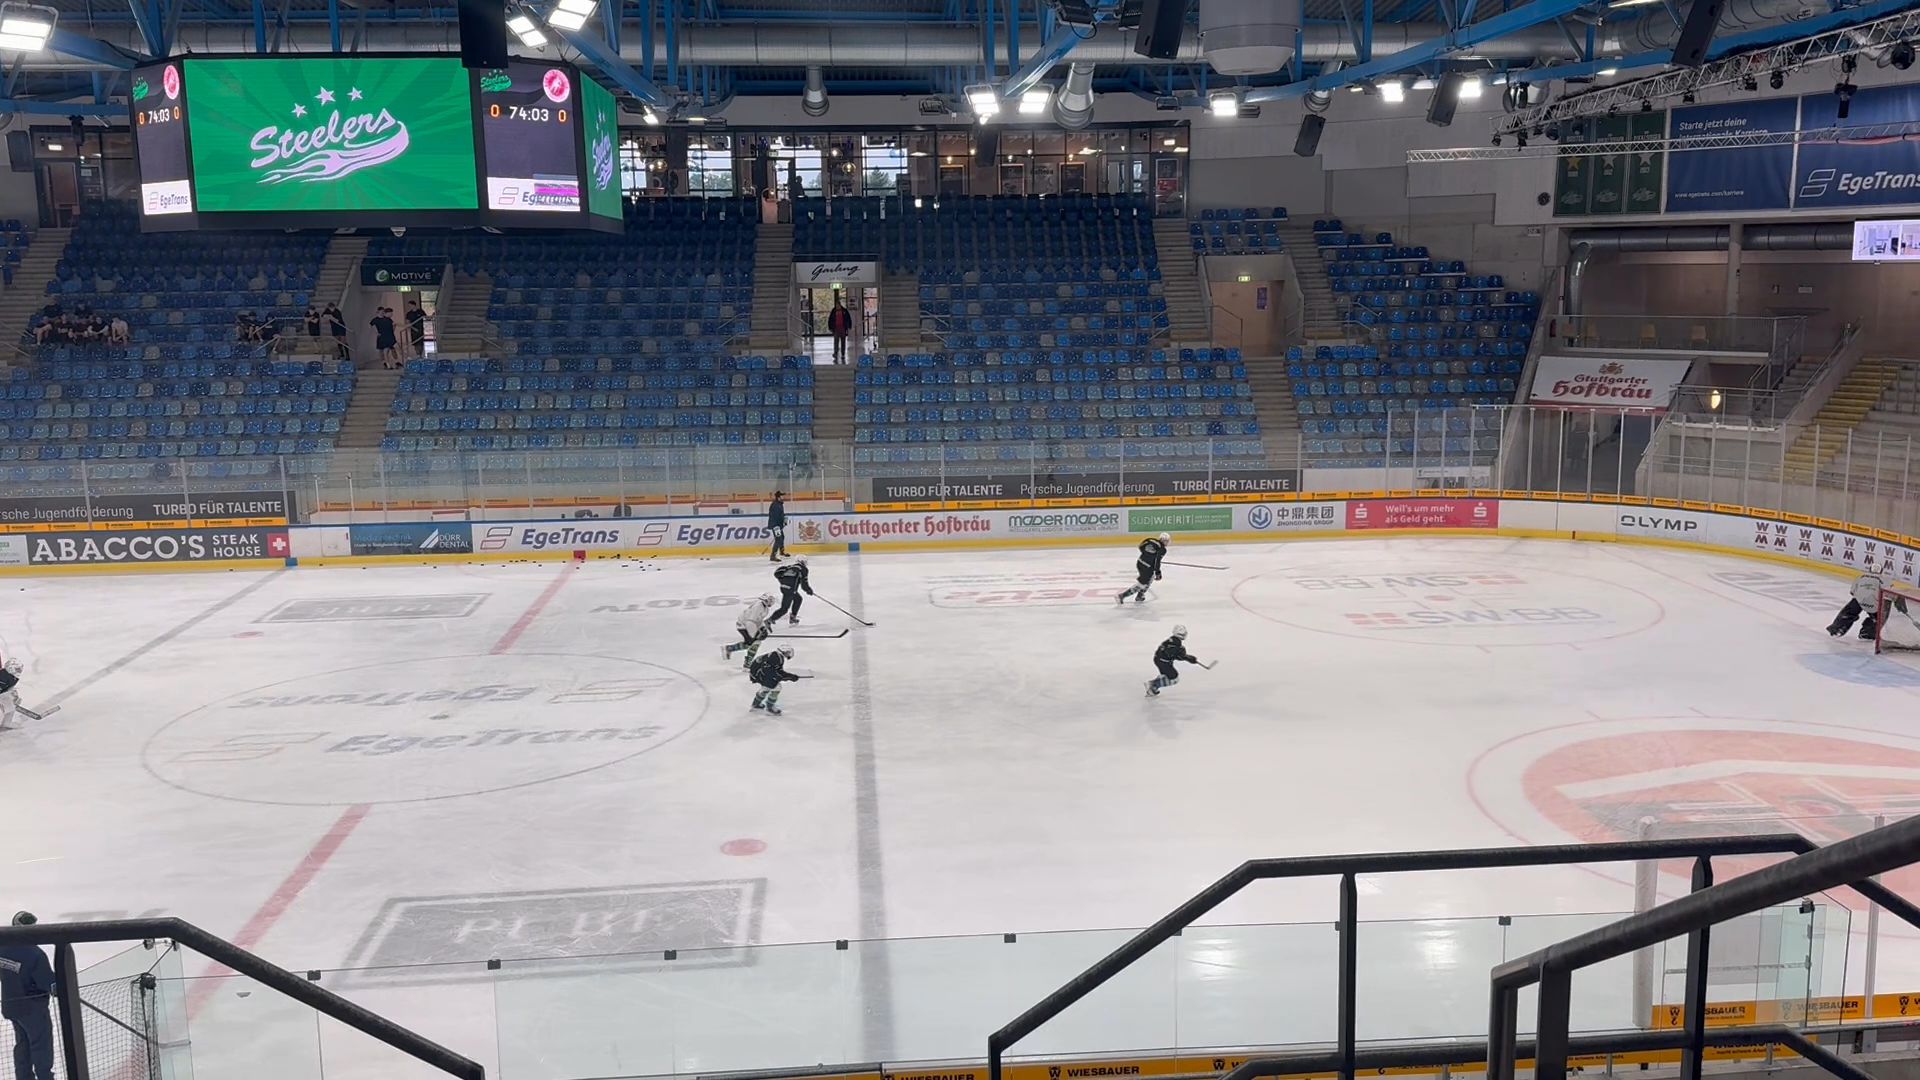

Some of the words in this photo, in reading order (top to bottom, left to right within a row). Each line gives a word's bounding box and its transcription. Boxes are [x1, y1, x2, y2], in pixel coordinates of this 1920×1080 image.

[139, 112, 145, 125] 0
[148, 108, 170, 124] 74:03
[174, 106, 180, 120] 0
[491, 104, 500, 117] 0
[509, 106, 549, 122] 74:03
[558, 109, 567, 122] 0
[1679, 122, 1703, 131] Starte
[1704, 120, 1723, 130] jetzt
[1724, 118, 1747, 127] deine
[251, 108, 399, 168] Steelers
[1837, 171, 1920, 195] EgeTrans
[160, 194, 188, 209] EgeTrans
[1574, 374, 1648, 385] Stuttgarter
[1552, 380, 1652, 399] Hofbräu
[887, 486, 926, 497] TURBO
[928, 483, 950, 496] FÜR
[952, 484, 1003, 496] TALENTE
[1021, 483, 1063, 494] Porsche
[1173, 481, 1209, 492] TURBO
[1214, 477, 1237, 491] FÜR
[1239, 479, 1290, 490] TALENTE
[0, 509, 29, 520] sche
[33, 506, 134, 521] Jugendföderung
[153, 503, 196, 515] TURBO
[200, 500, 224, 514] FÜR
[226, 501, 282, 514] TALENTE
[1277, 506, 1334, 520] 中鼎集团
[1430, 504, 1455, 513] mehr
[828, 518, 920, 539] Stuttgarter
[924, 515, 991, 536] Hofbräu
[1385, 515, 1397, 523] als
[1400, 515, 1420, 523] Geld
[1423, 515, 1446, 525] geht.
[1620, 514, 1698, 531] OLYMP
[440, 533, 461, 541] DÜRR
[521, 528, 619, 549] EgeTrans
[677, 524, 771, 545] EgeTrans
[32, 535, 205, 562] ABACCO'S
[212, 533, 259, 545] STEAK
[213, 546, 261, 557] HOUSE
[325, 725, 667, 757] EgeTrans
[1704, 1006, 1746, 1015] SBAUER
[1067, 1066, 1140, 1077] WIESBAUER
